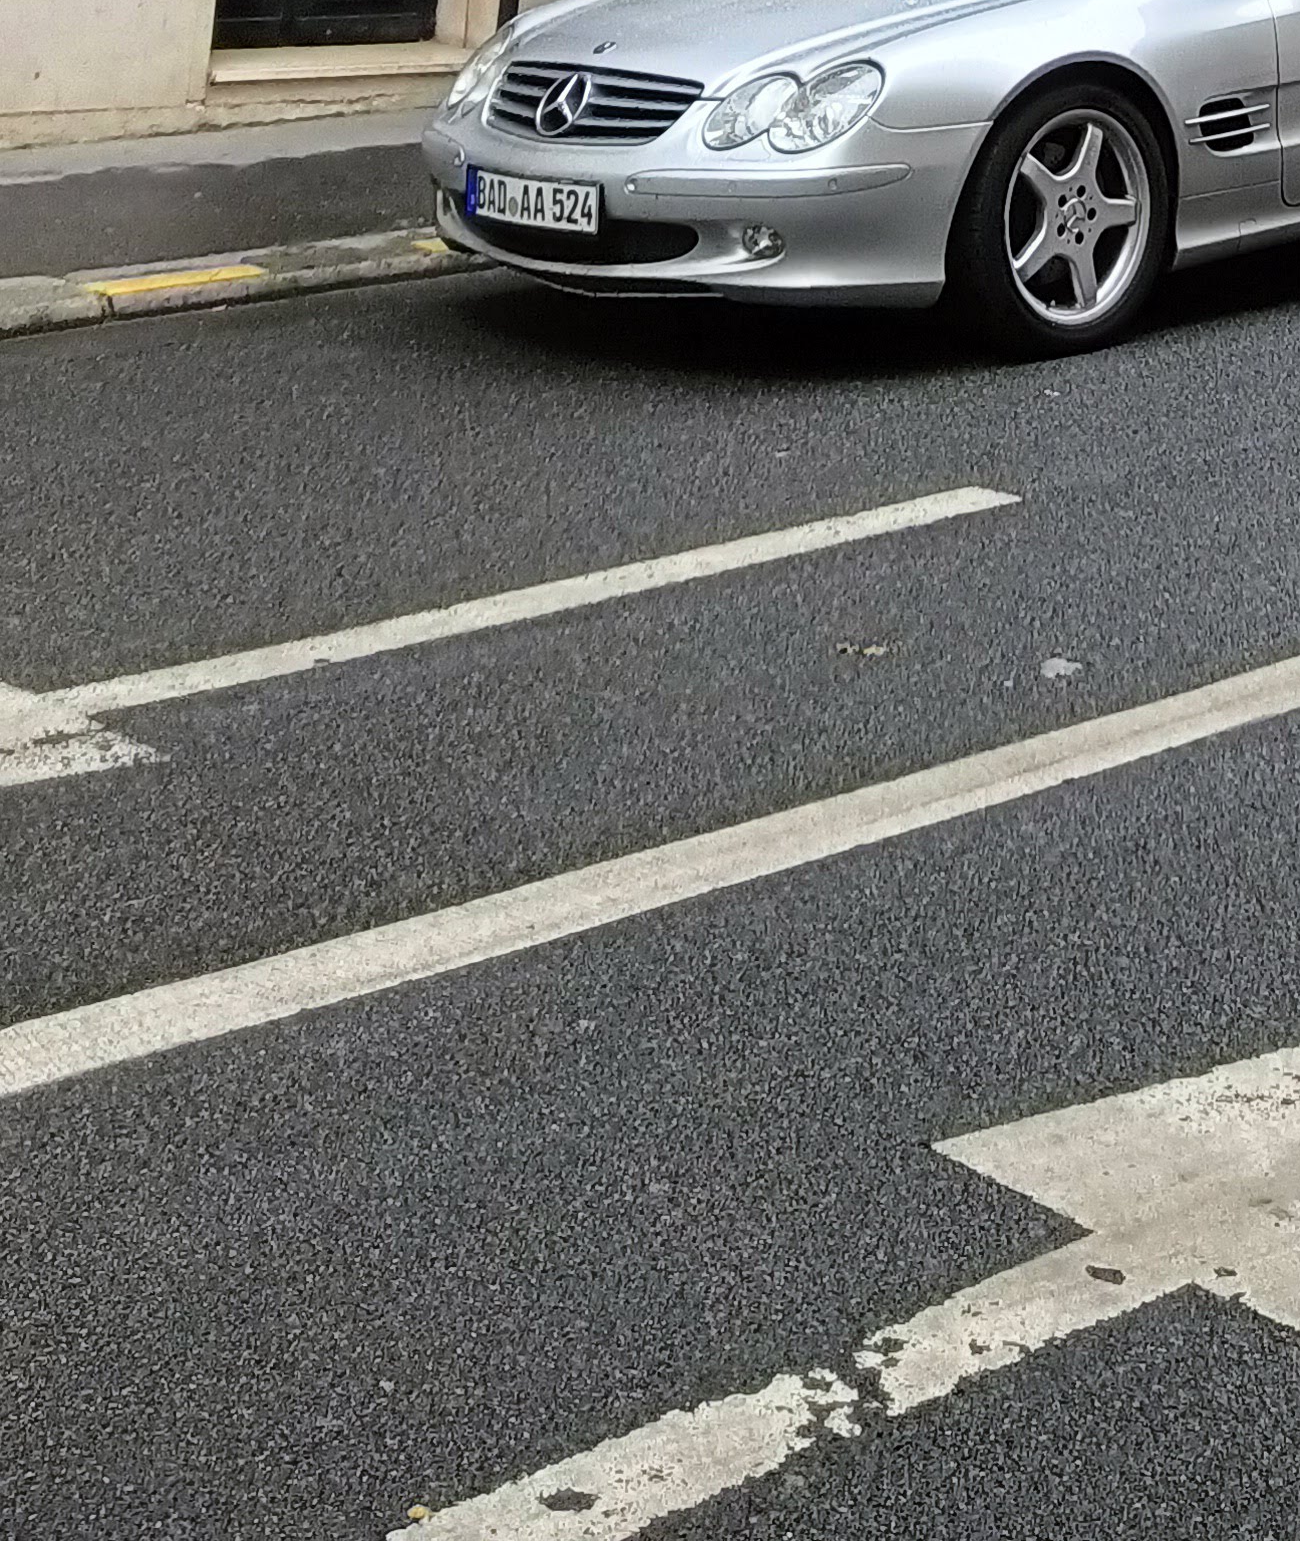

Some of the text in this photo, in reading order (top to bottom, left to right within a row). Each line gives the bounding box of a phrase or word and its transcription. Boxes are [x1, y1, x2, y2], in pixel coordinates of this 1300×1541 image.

[477, 175, 593, 226] BAD AA 524
